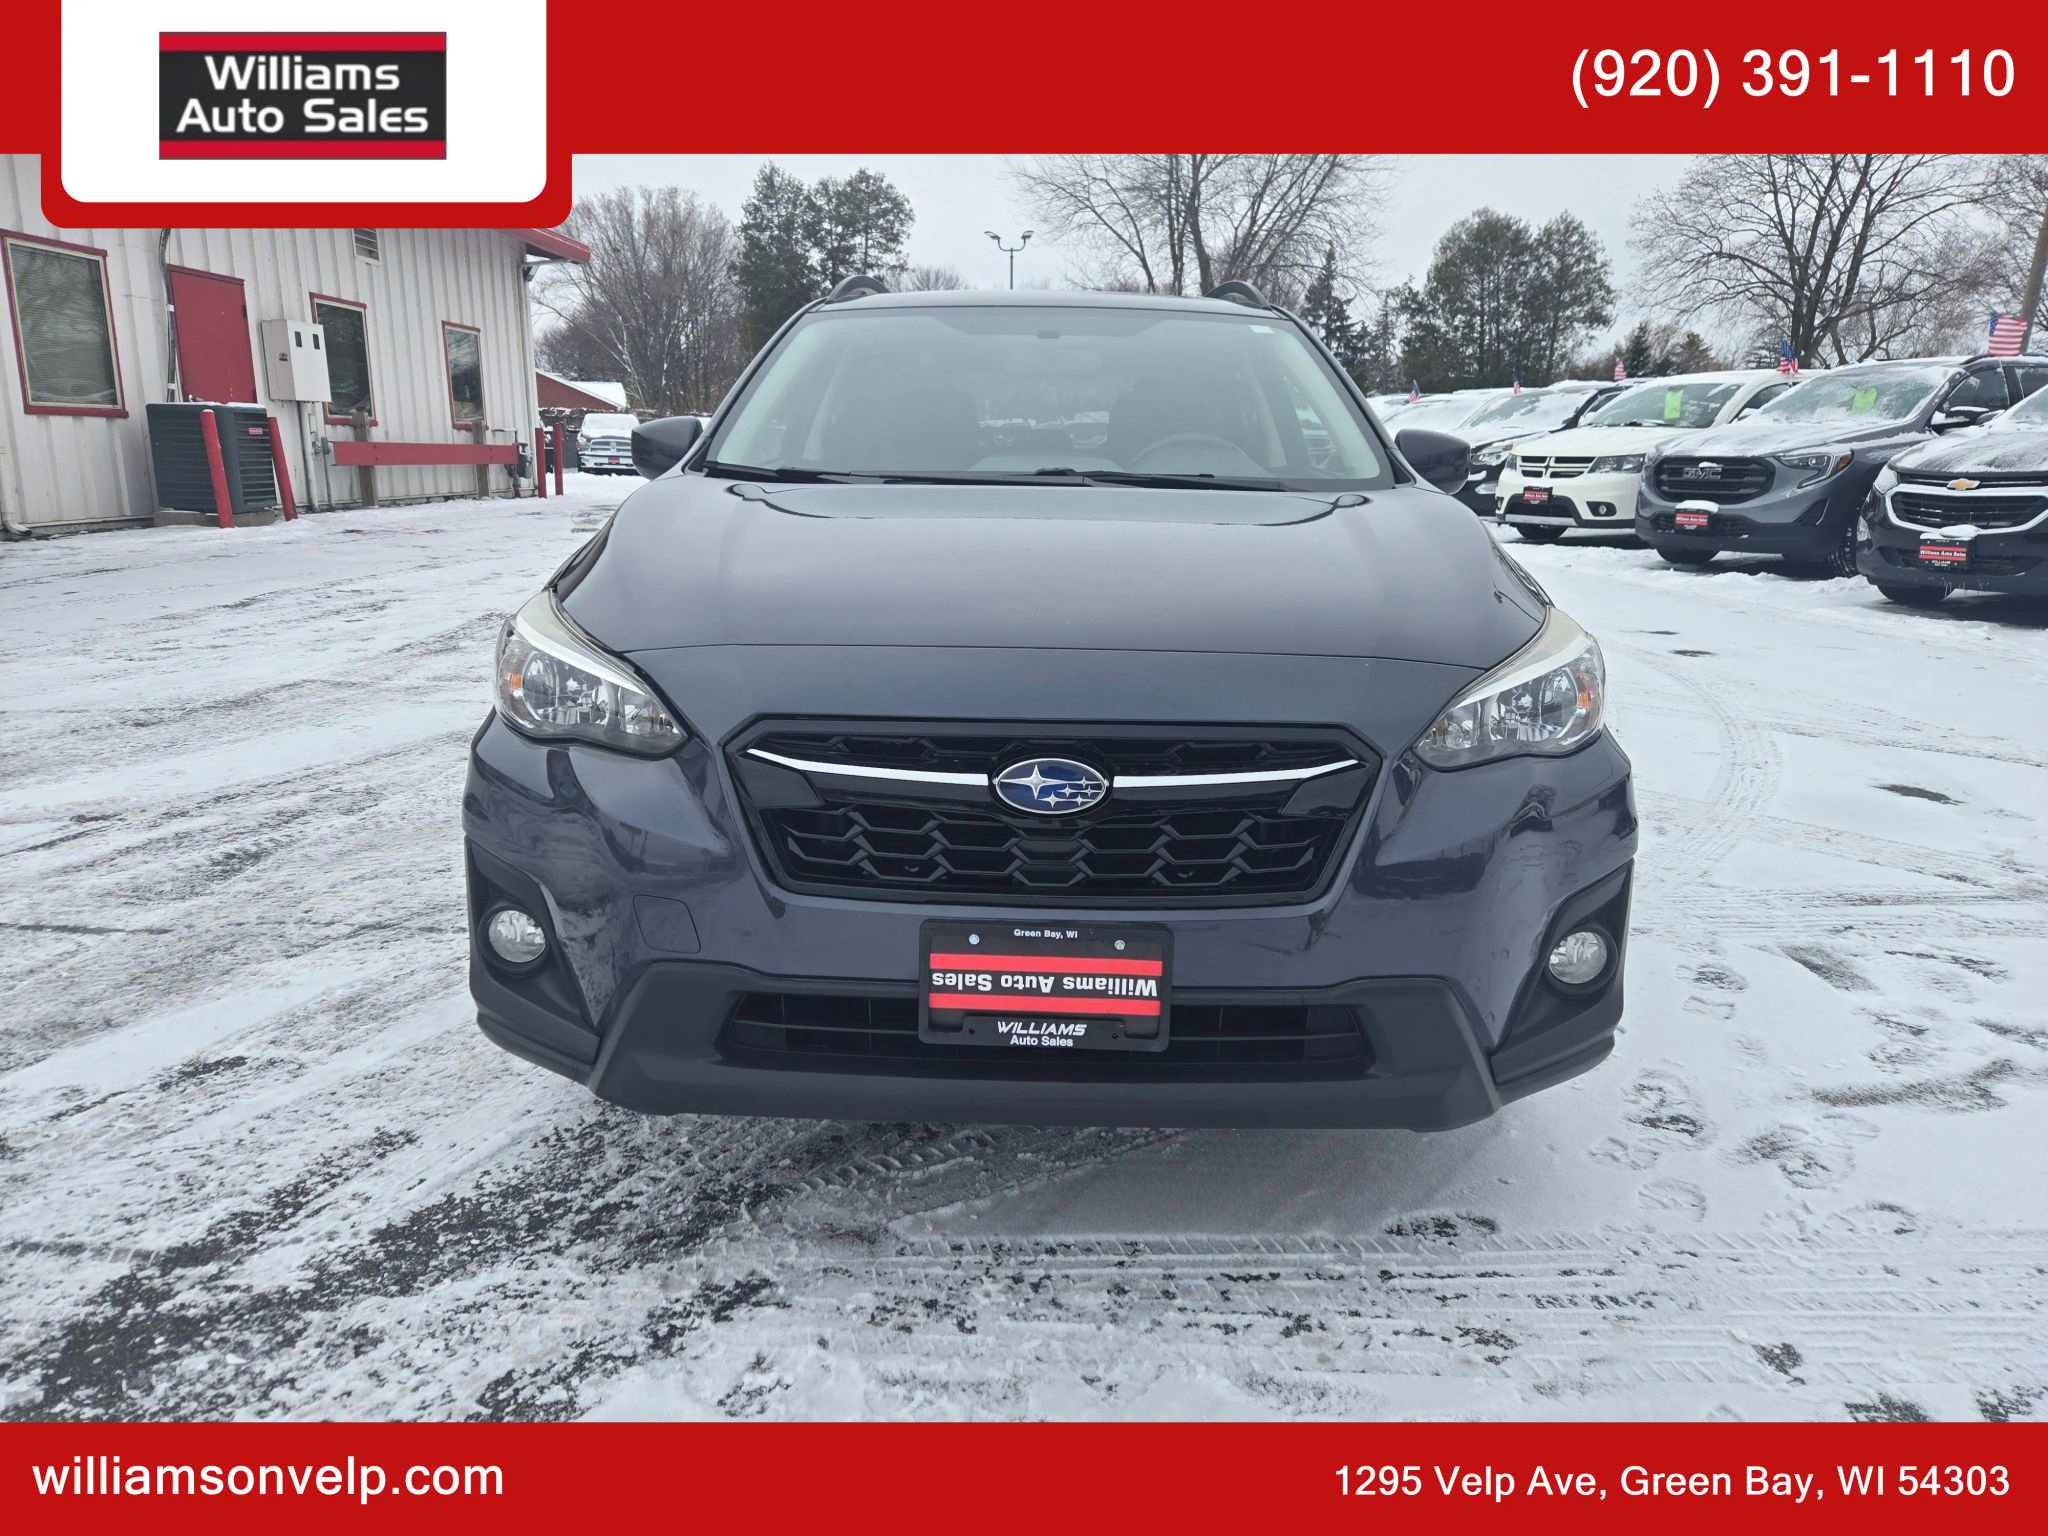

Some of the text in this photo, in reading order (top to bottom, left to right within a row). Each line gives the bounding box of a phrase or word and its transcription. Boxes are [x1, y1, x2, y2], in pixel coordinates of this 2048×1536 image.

[1683, 467, 1722, 480] GMC
[1013, 928, 1078, 940] Green Bay, WI
[932, 972, 1158, 997] Williams Auto Sales
[997, 1020, 1088, 1036] WILLIAMS
[1009, 1034, 1074, 1048] Auto Sales
